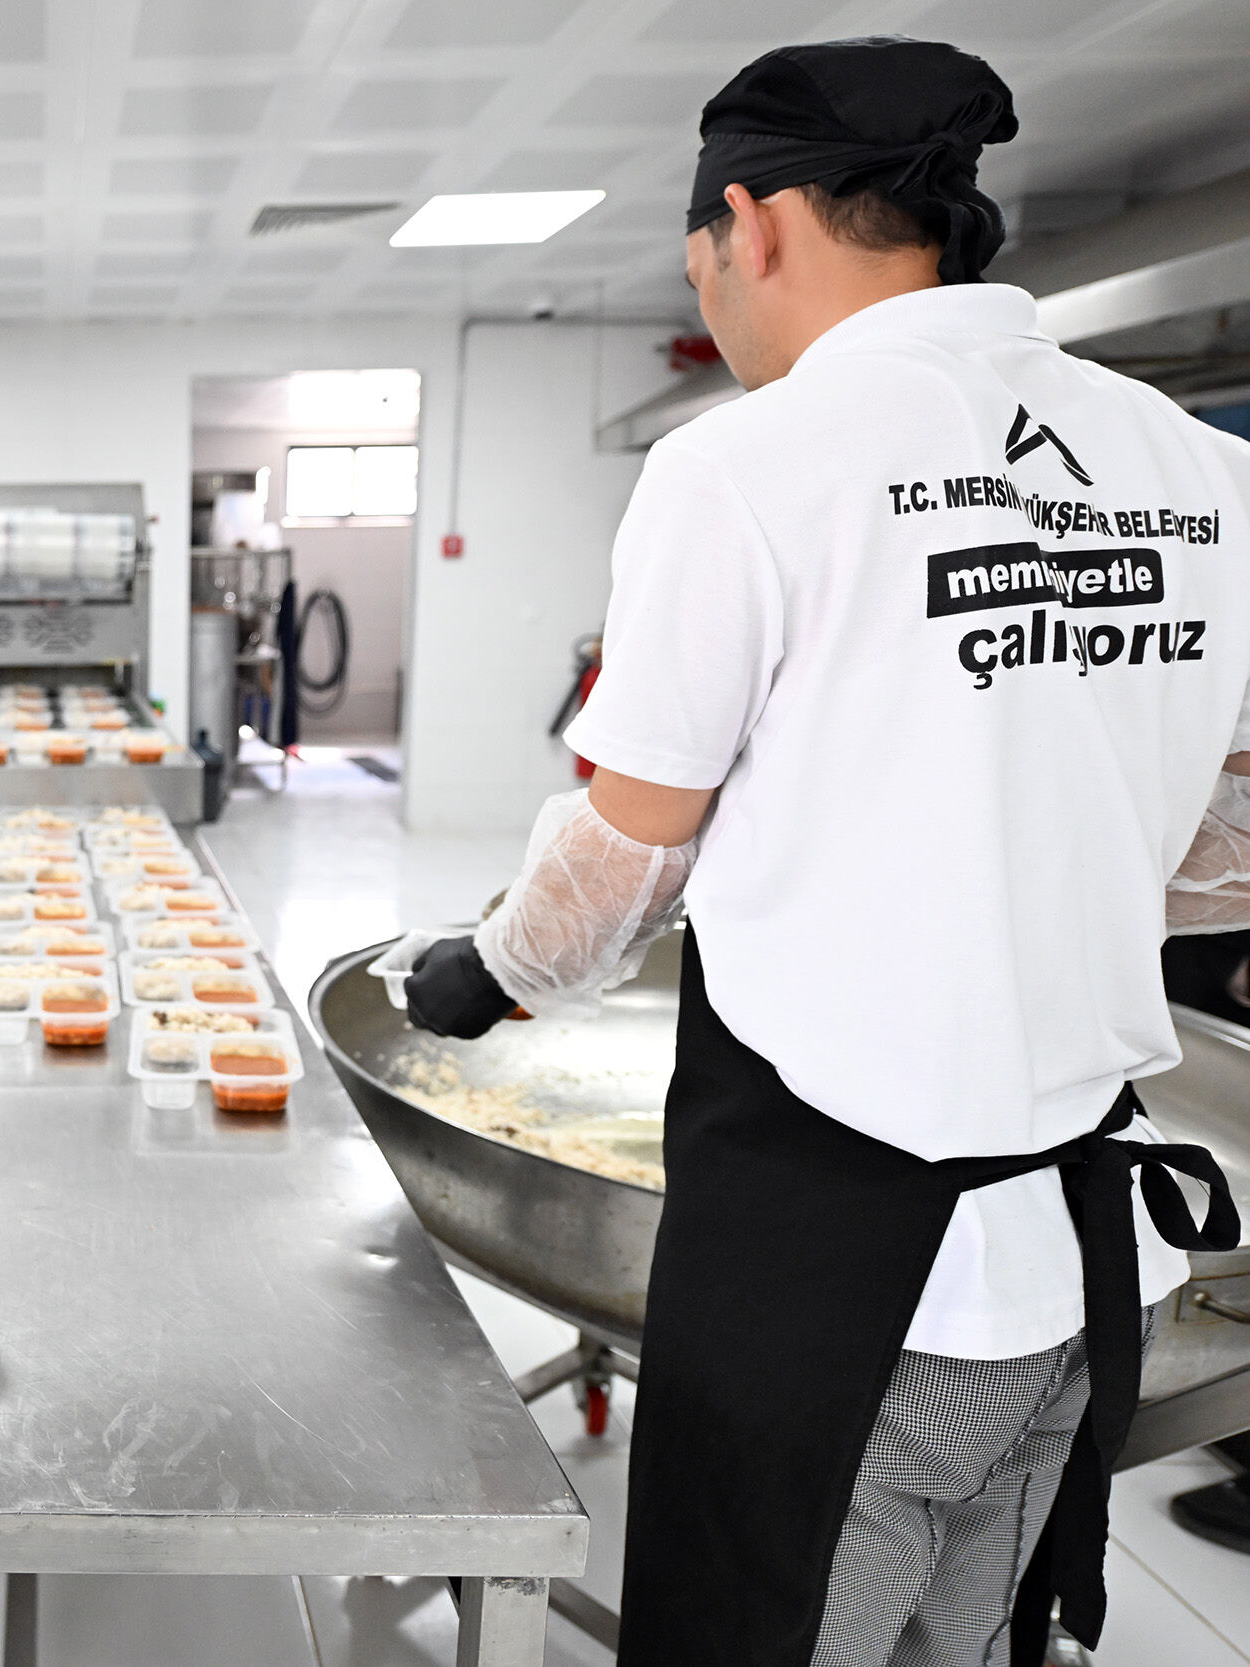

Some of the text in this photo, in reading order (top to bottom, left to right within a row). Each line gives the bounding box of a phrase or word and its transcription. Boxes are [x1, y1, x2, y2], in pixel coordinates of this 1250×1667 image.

[888, 483, 938, 515] T.C.
[943, 473, 1023, 511] MERSİN
[1113, 509, 1220, 545] BELEYESİ
